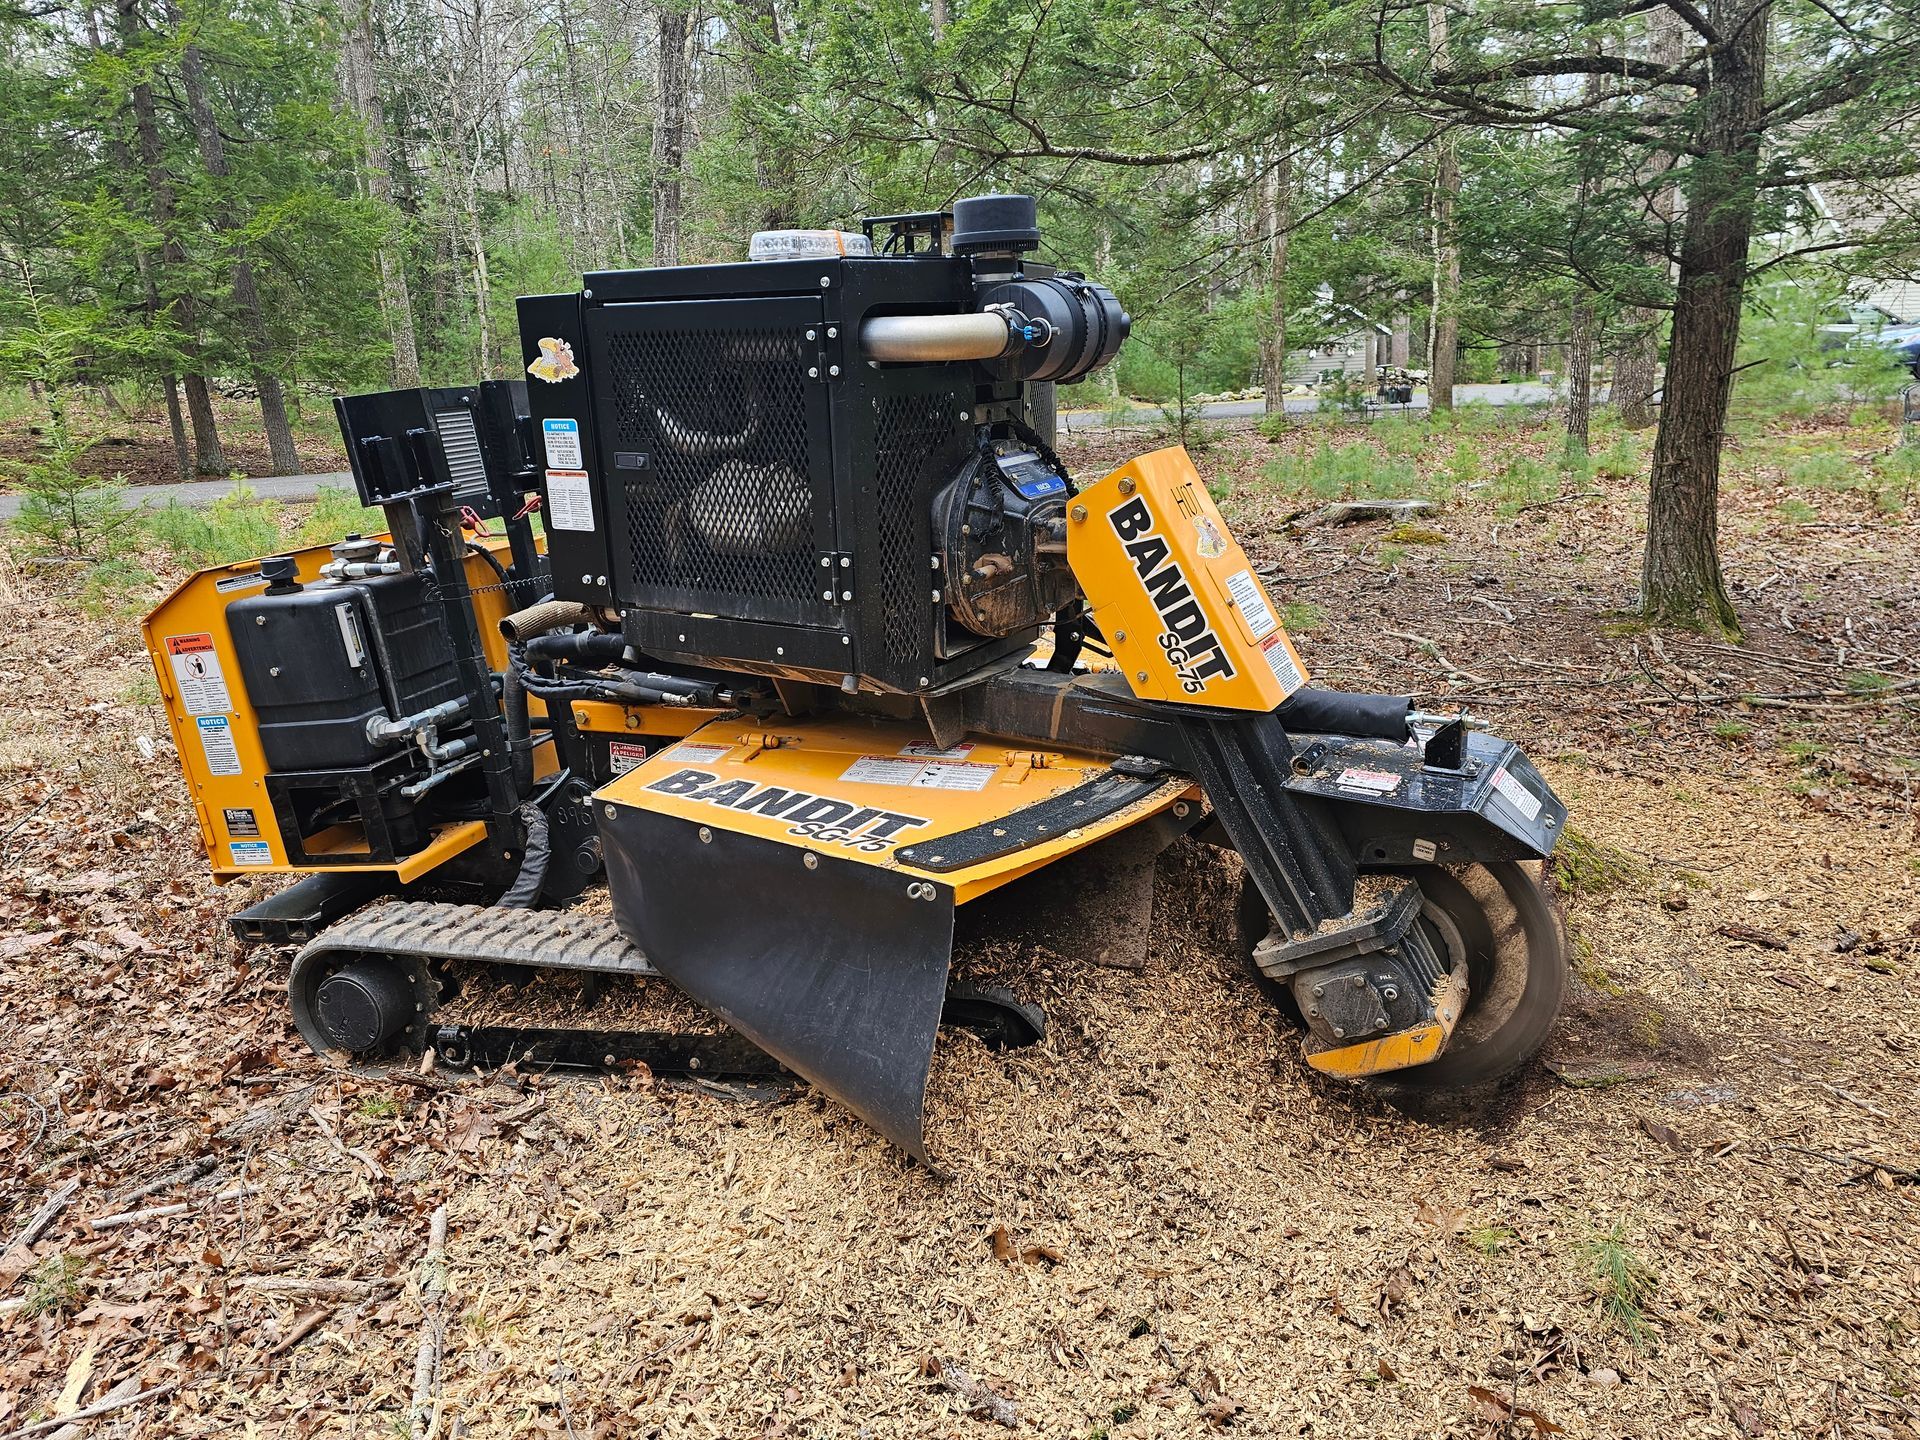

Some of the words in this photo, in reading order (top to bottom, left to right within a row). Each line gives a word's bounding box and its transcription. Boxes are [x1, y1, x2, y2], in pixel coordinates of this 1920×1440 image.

[1109, 496, 1235, 679] BANDIT
[1159, 633, 1205, 694] SG-75
[644, 769, 931, 838] BANDIT
[791, 823, 896, 852] SG-75
